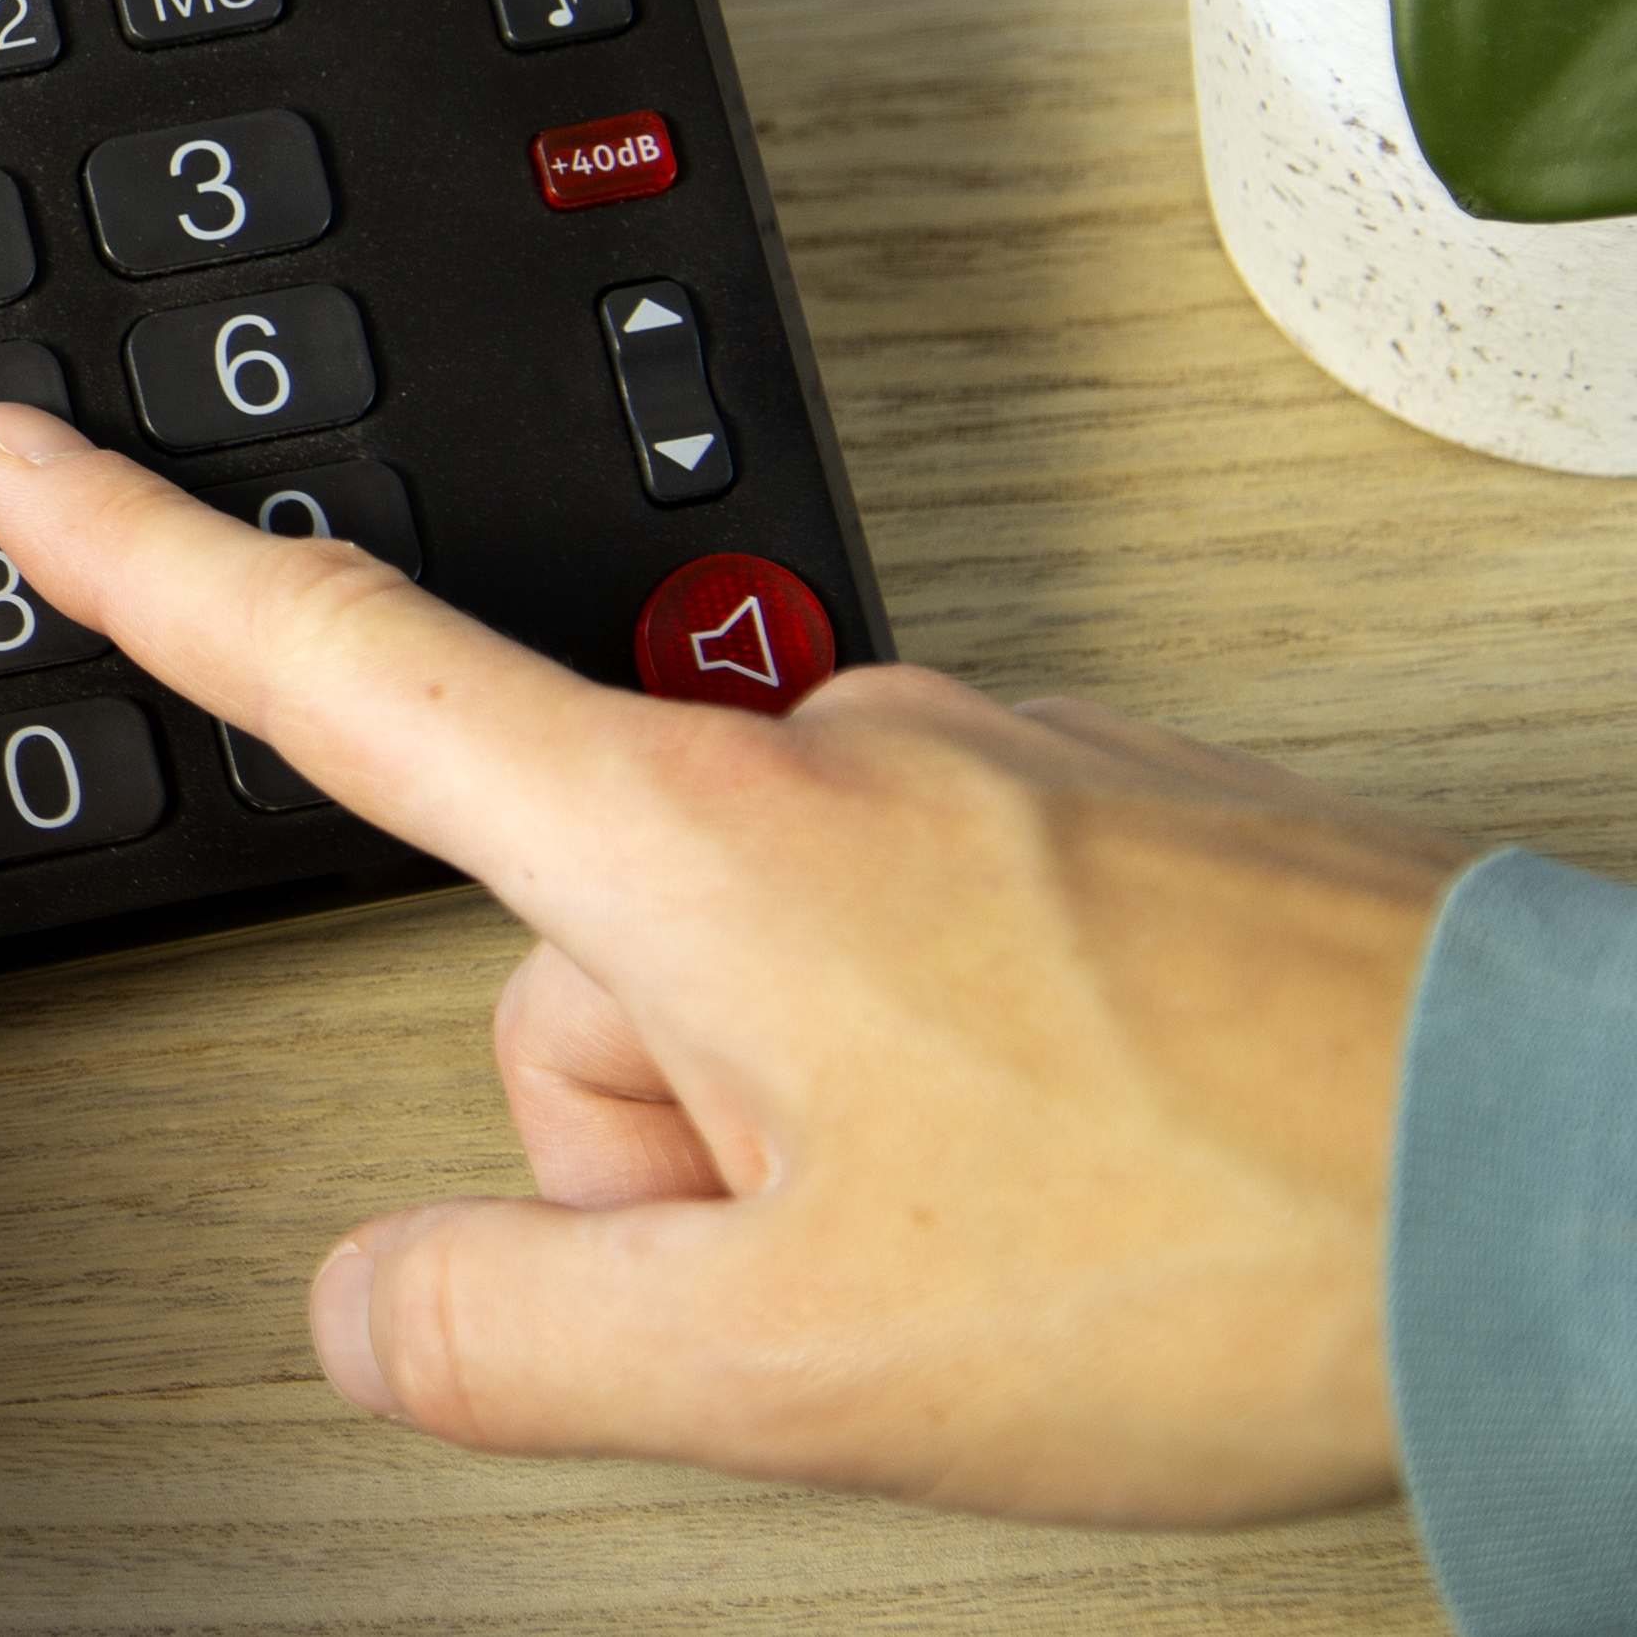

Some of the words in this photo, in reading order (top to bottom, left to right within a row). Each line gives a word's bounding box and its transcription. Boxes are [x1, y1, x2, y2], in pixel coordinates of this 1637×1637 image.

[169, 139, 247, 241] 3
[550, 134, 661, 175] +40dB
[214, 314, 291, 416] 6
[3, 725, 82, 829] 0
